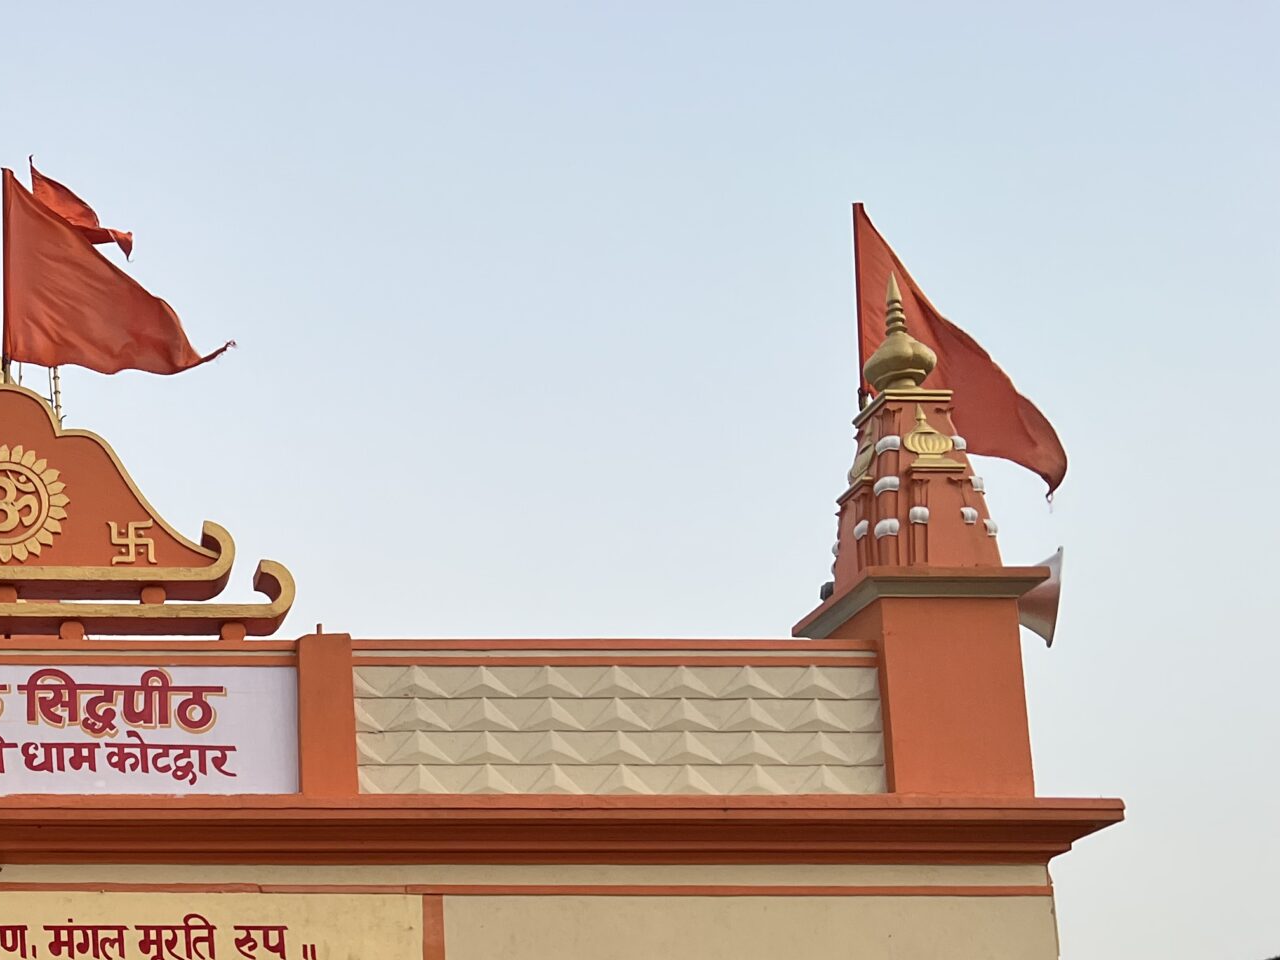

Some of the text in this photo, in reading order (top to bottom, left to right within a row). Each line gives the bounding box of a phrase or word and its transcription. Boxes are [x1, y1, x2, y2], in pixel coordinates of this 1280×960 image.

[17, 667, 226, 738] सिद्धपीठ
[21, 741, 101, 773] धाम
[104, 730, 237, 785] कोटद्वार
[43, 918, 129, 960] मंगल
